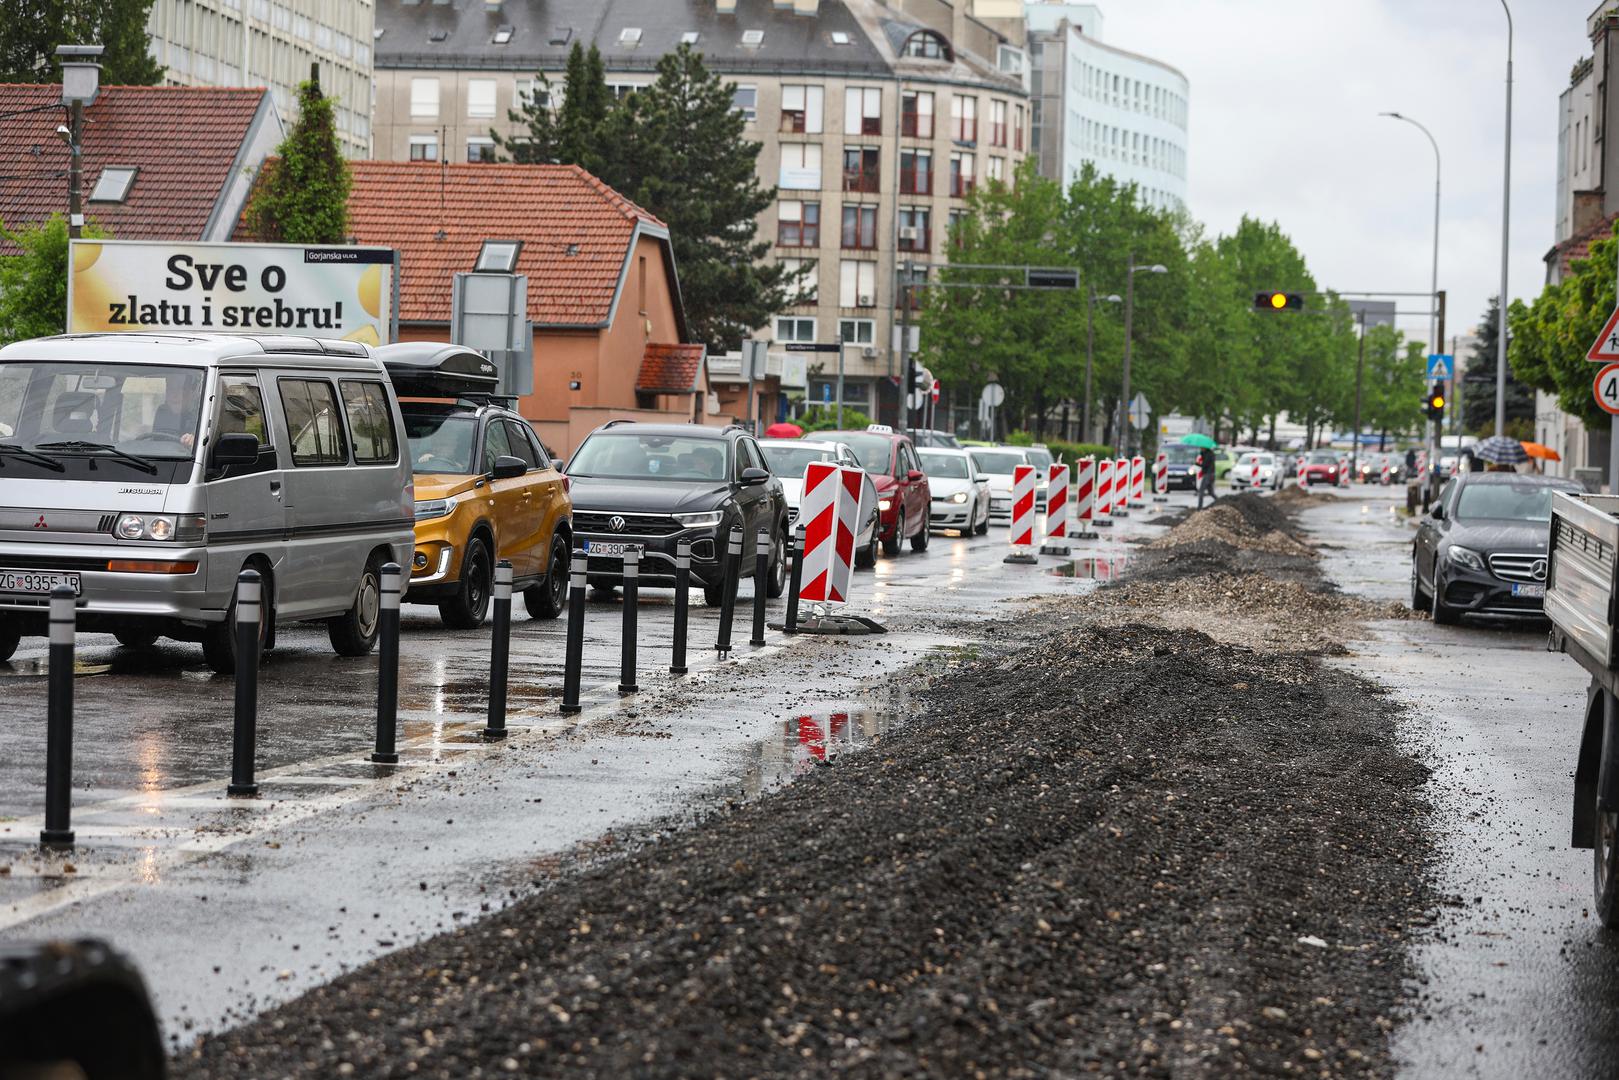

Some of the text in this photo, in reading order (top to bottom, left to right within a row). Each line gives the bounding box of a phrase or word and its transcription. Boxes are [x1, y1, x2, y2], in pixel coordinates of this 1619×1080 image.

[308, 251, 342, 261] Gorjanska
[165, 253, 286, 293] Sve o
[108, 295, 343, 329] zlatu i srebru!
[589, 543, 602, 553] ZG
[0, 573, 15, 589] ZG
